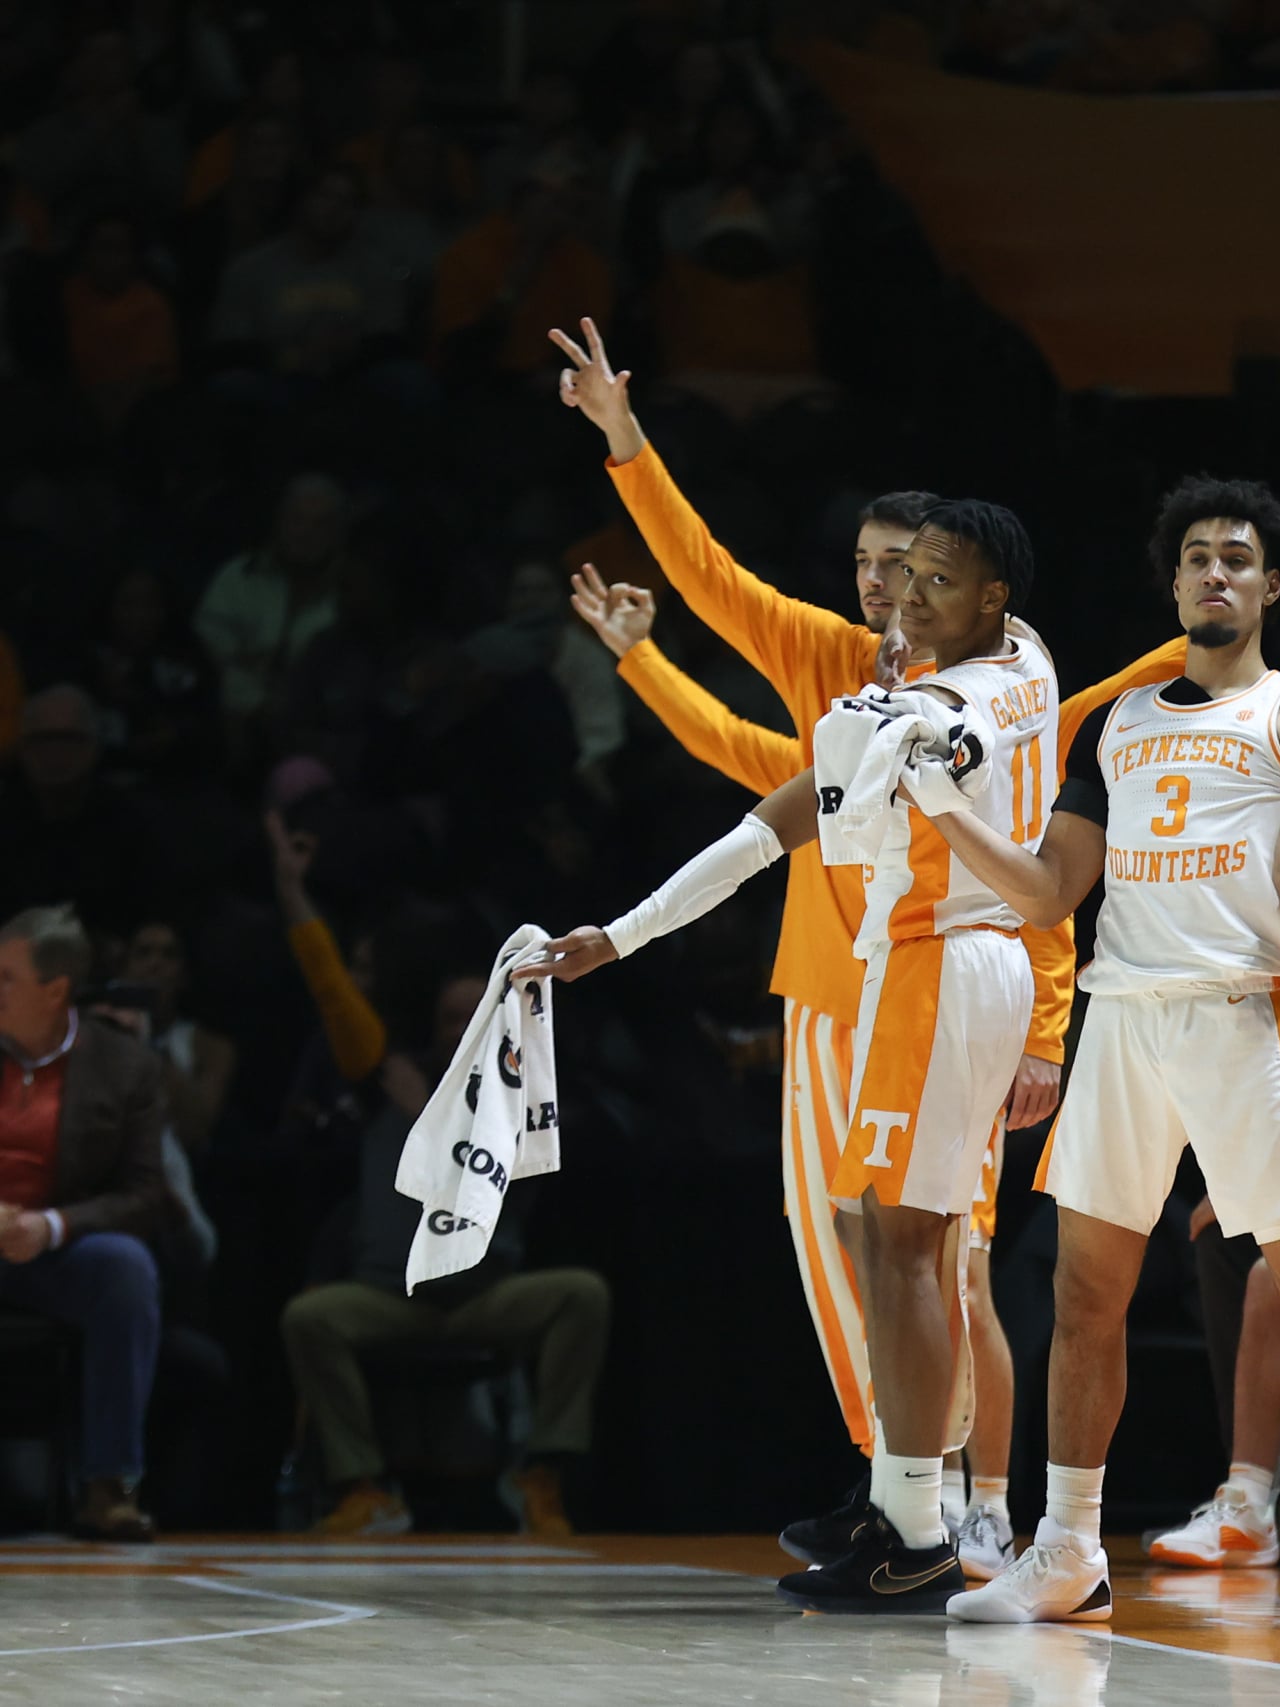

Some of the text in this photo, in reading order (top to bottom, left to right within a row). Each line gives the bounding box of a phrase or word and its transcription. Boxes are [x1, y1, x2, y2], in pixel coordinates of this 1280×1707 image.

[990, 677, 1048, 730] GAINEY
[1112, 734, 1254, 782] TENNESSEE
[1010, 736, 1042, 844] 11
[1150, 775, 1191, 837] 3
[1107, 840, 1248, 883] VOLUNTEERS
[860, 1108, 910, 1169] T
